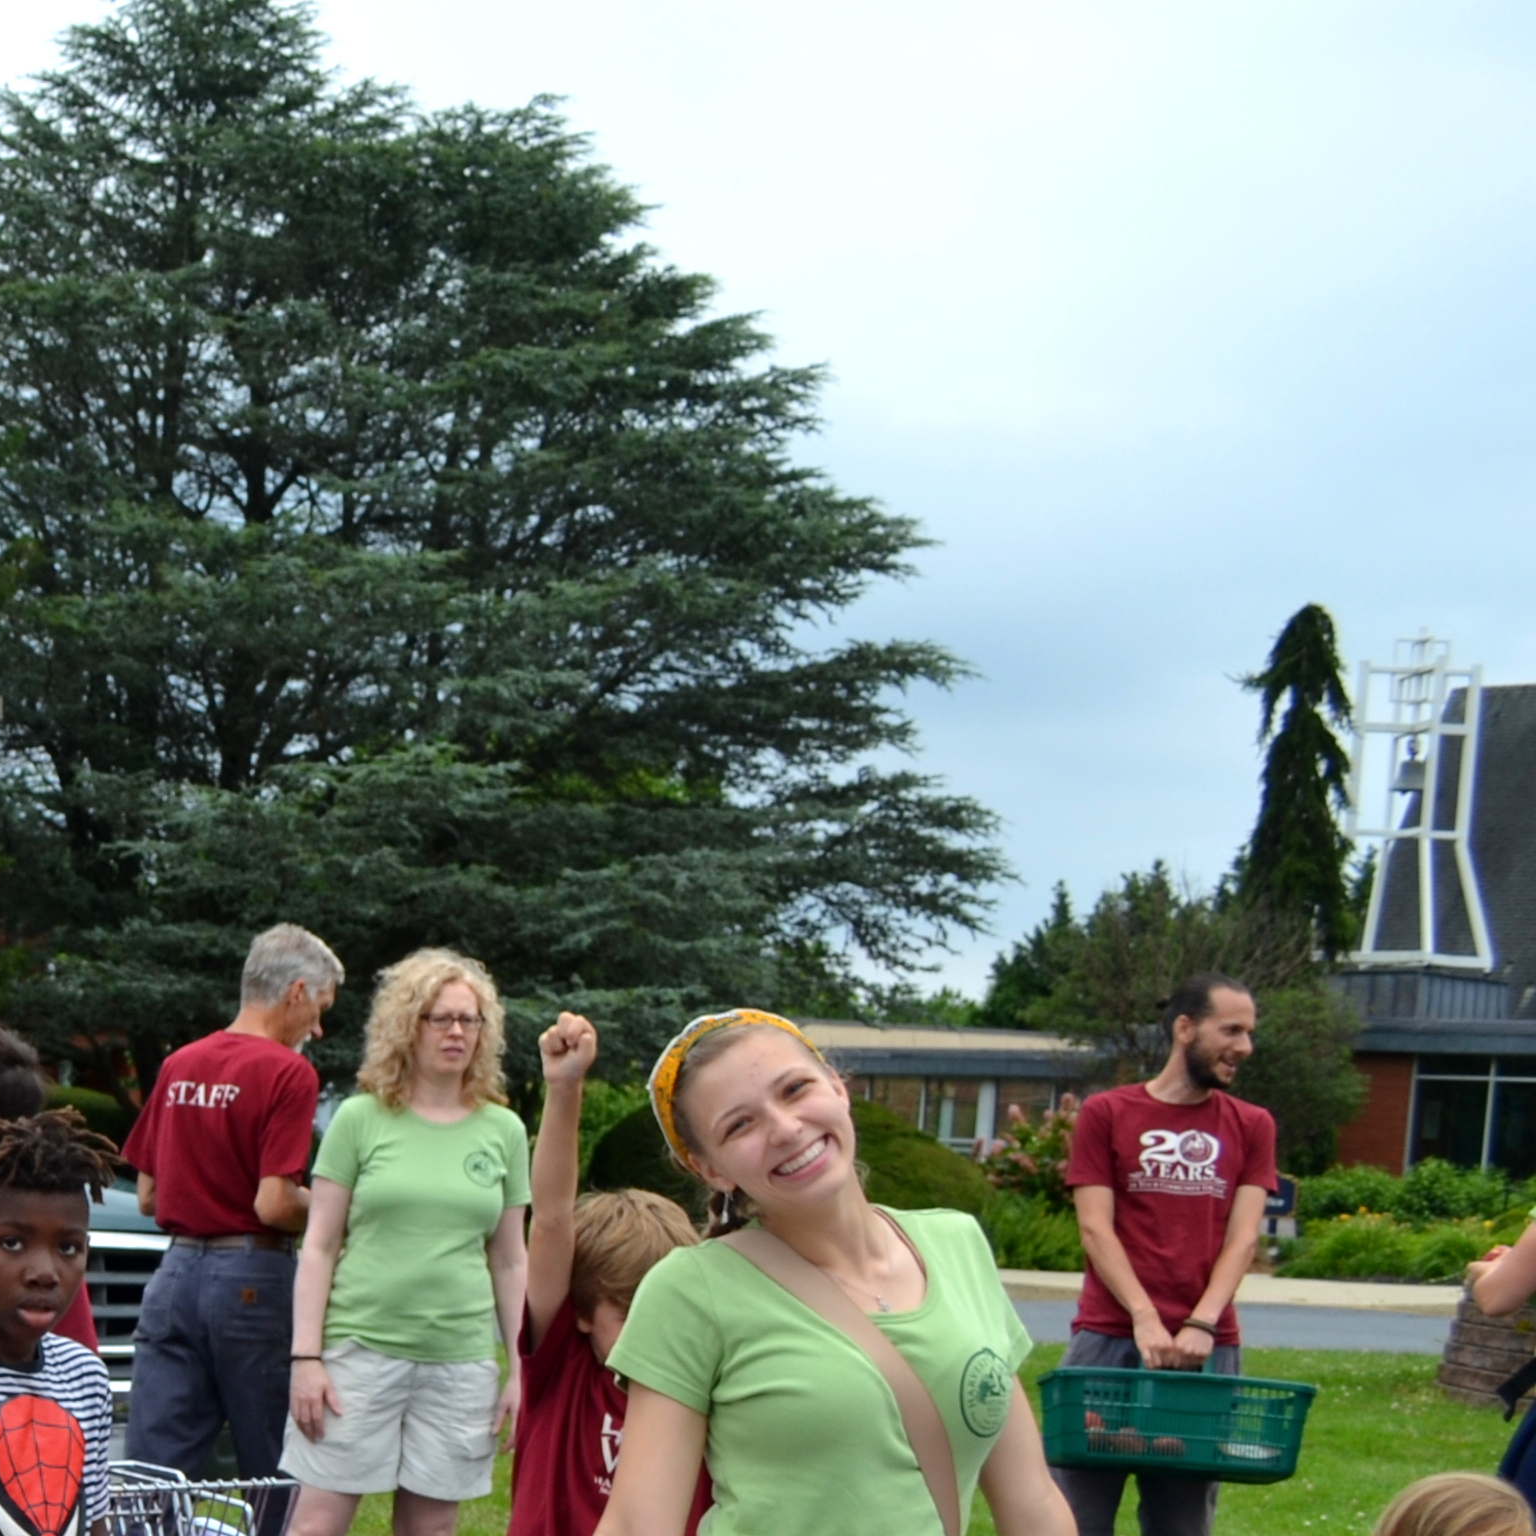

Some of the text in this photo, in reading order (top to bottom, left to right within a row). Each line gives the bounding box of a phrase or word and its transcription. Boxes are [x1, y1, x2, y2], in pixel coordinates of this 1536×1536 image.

[166, 1080, 240, 1108] STAFF
[1139, 1129, 1220, 1166] 20
[1140, 1162, 1217, 1180] YEARS
